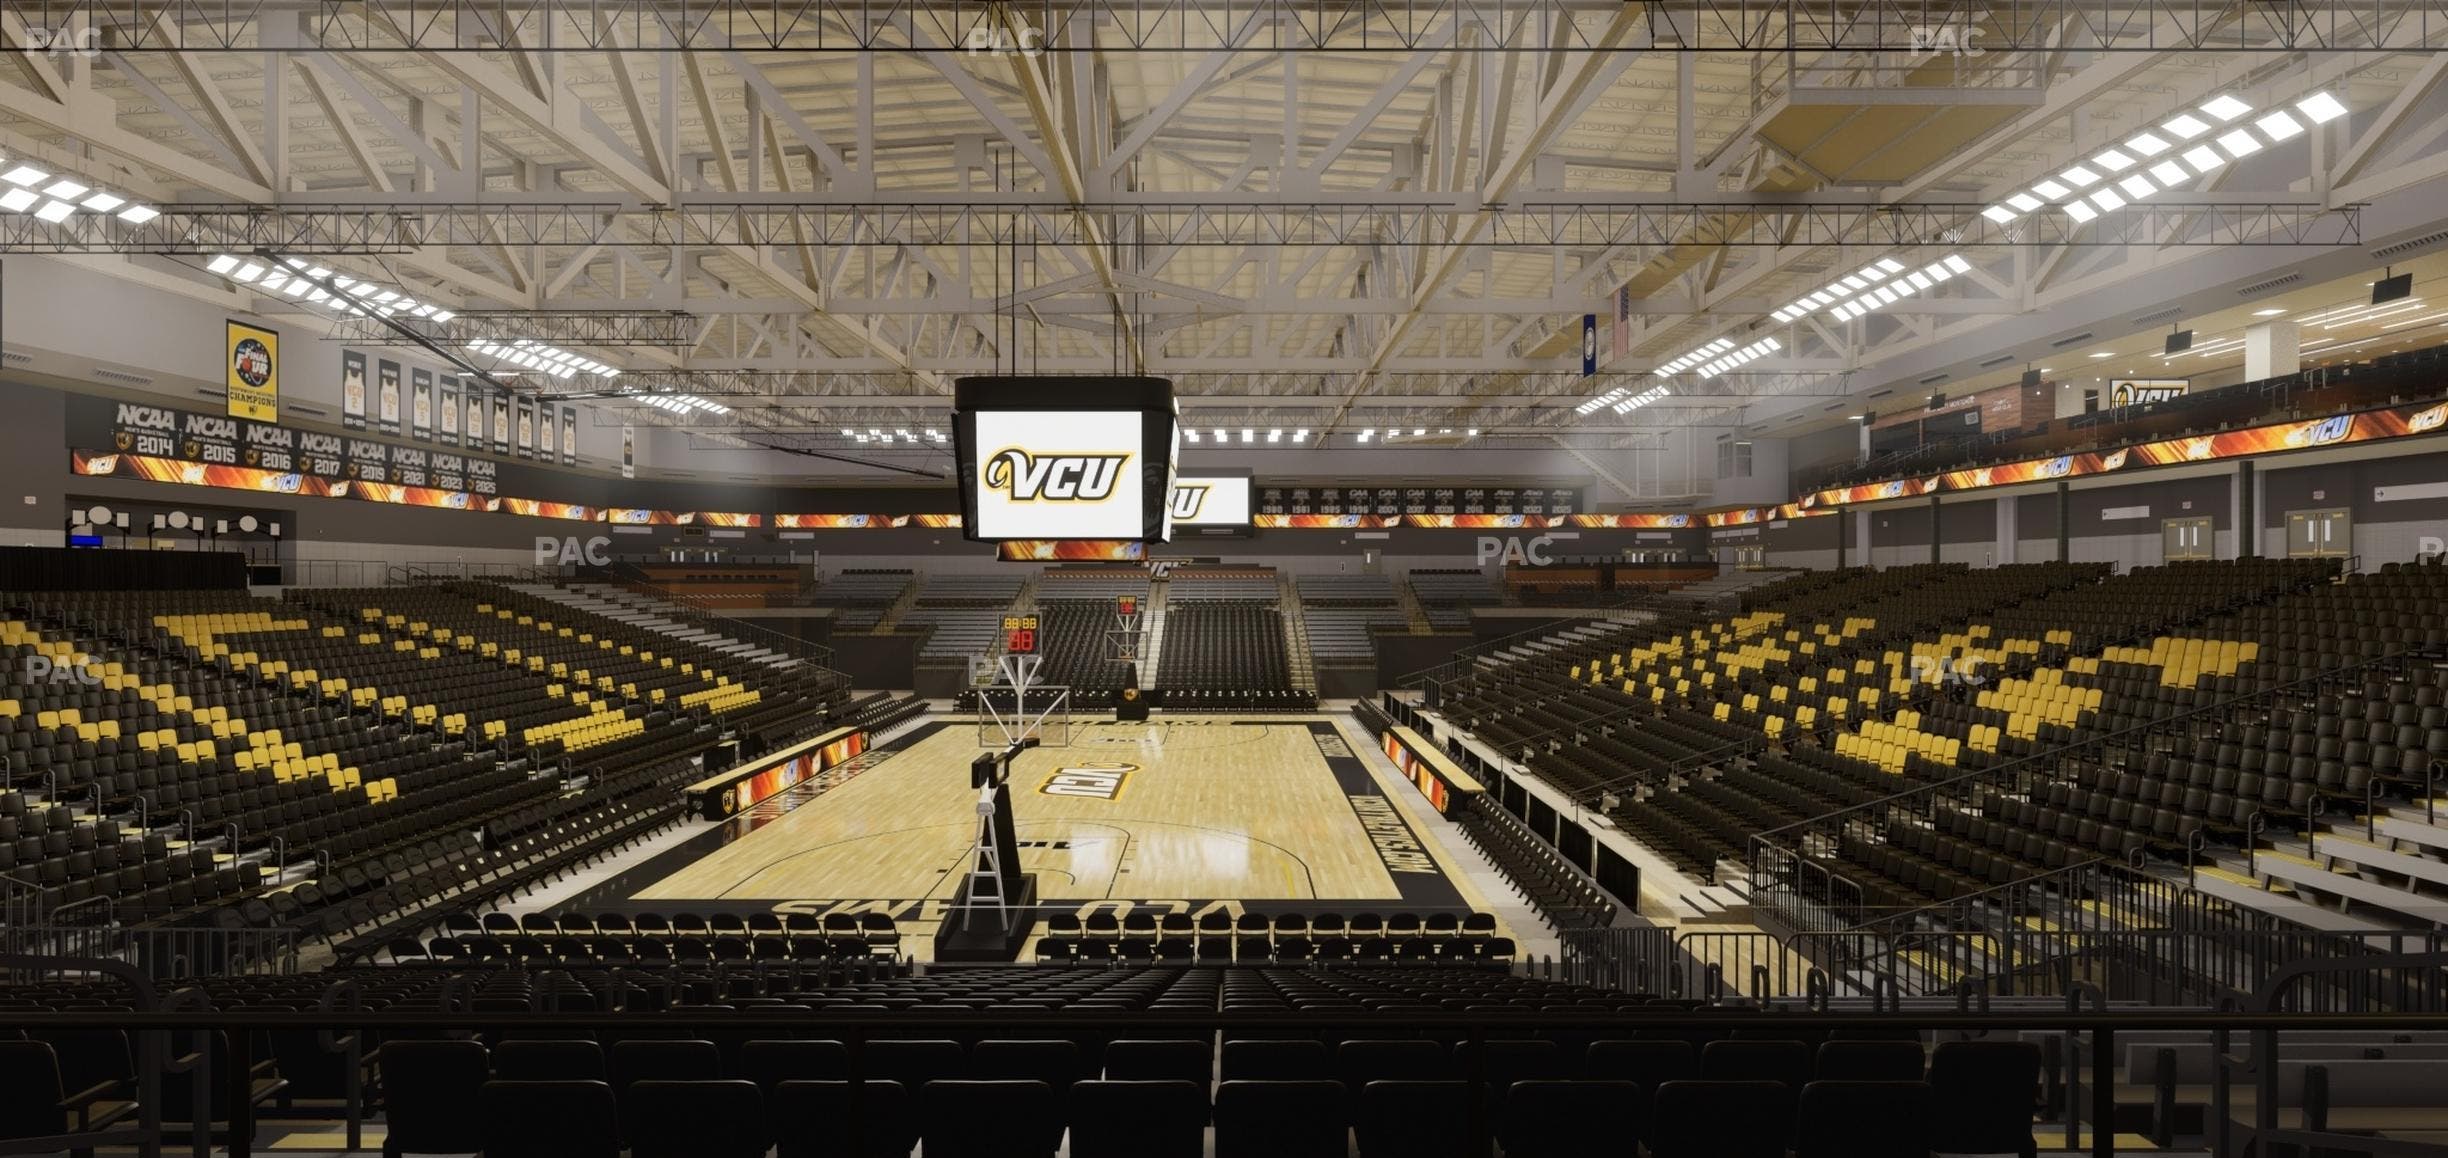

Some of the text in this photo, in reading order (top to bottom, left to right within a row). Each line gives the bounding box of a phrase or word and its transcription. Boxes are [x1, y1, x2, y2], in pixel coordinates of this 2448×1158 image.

[244, 345, 269, 363] FINAL
[230, 391, 276, 407] CHAMPIONS
[116, 403, 176, 431] NCAA
[185, 414, 238, 440] NCAA
[245, 424, 293, 448] NCAA
[2311, 413, 2353, 444] VCU
[137, 435, 173, 456] 2014
[300, 432, 342, 455] NCAA
[348, 440, 386, 461] NCAA
[203, 444, 236, 463] 2015
[262, 452, 291, 470] 2016
[392, 446, 426, 467] NCAA
[431, 453, 463, 472] NCAA
[89, 456, 118, 474] VCU
[314, 458, 340, 476] 2017
[361, 465, 385, 481] 2019
[467, 458, 496, 477] NCAA
[984, 448, 1130, 501] VCU
[403, 470, 425, 485] 2021
[440, 474, 463, 490] 2023
[475, 480, 496, 494] 2025
[1003, 617, 1037, 630] 88:88
